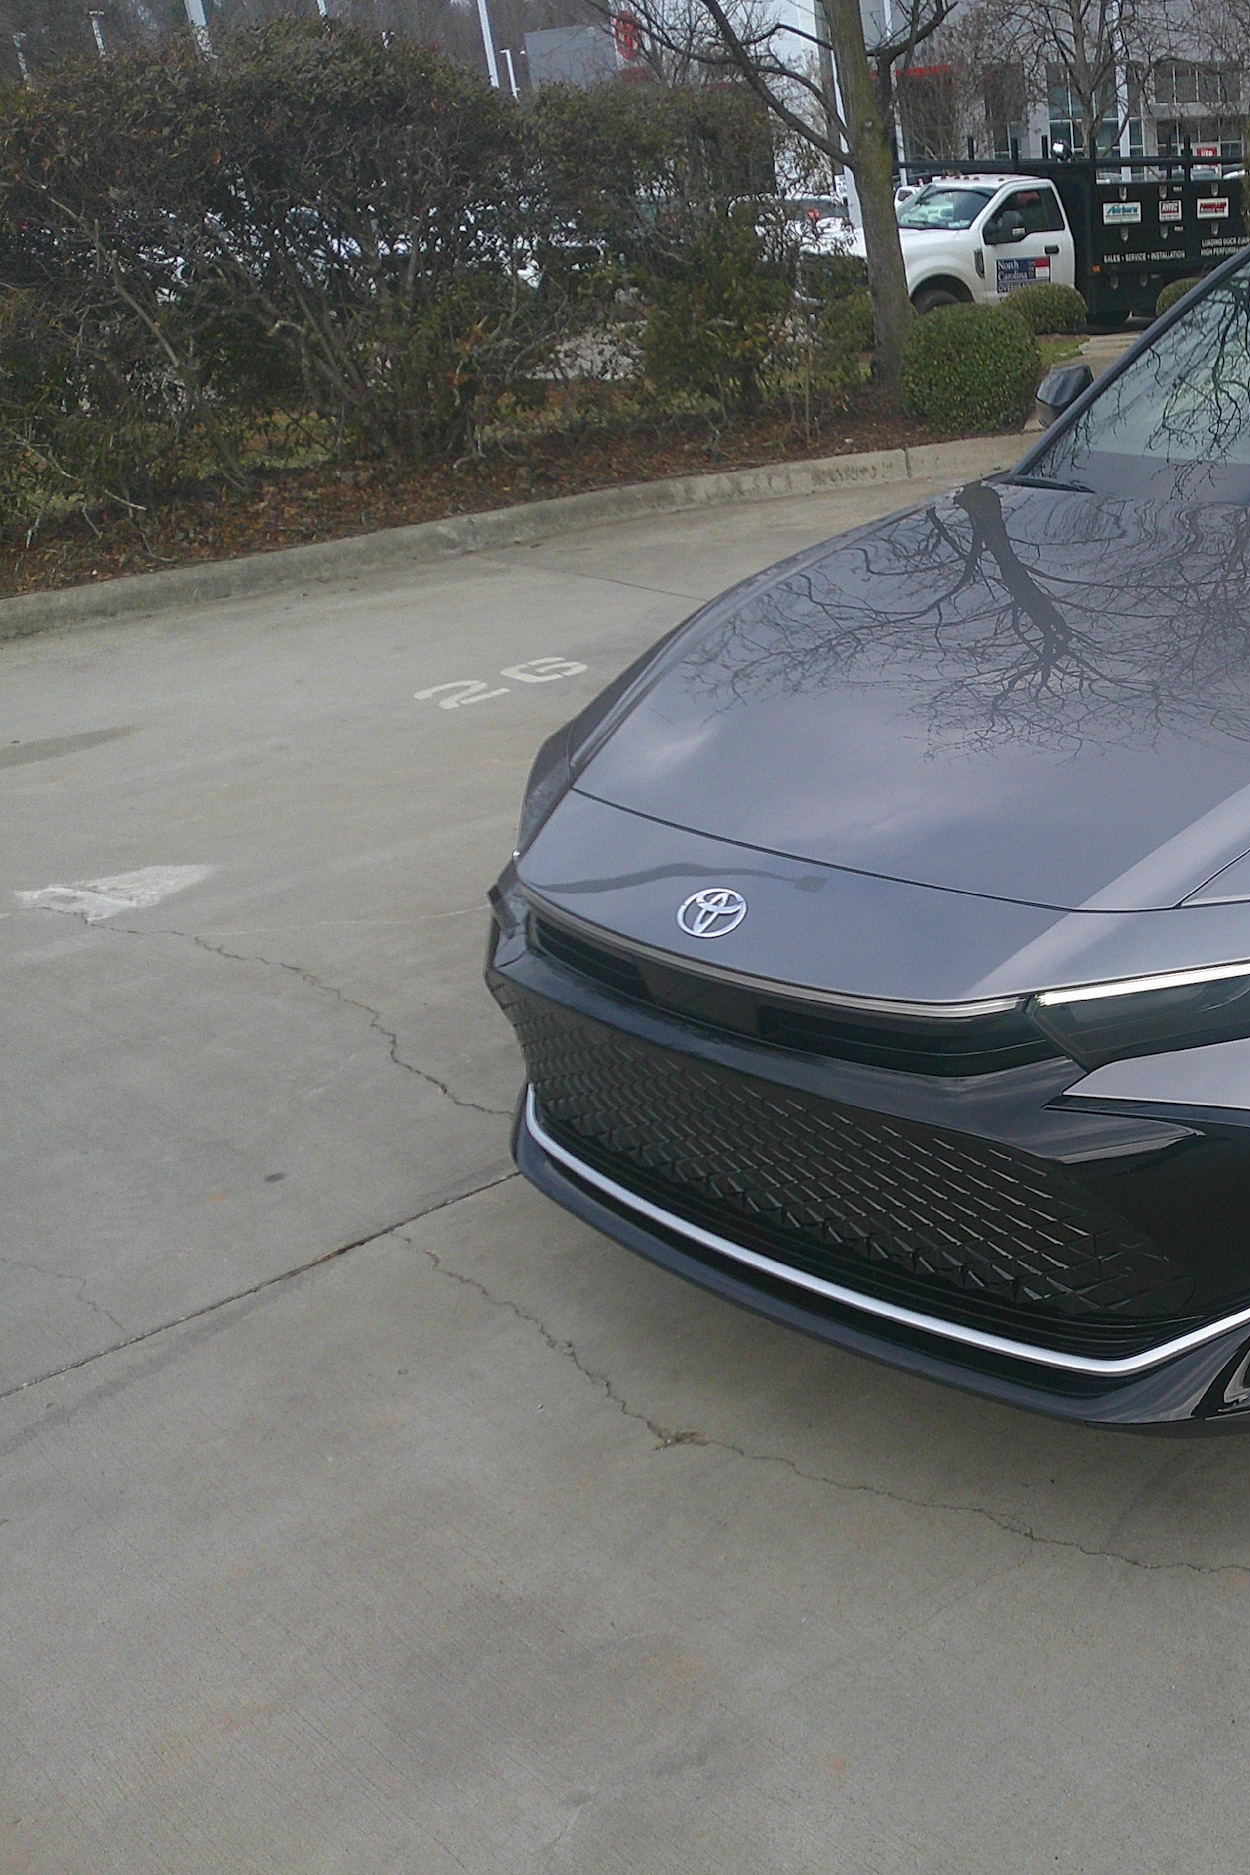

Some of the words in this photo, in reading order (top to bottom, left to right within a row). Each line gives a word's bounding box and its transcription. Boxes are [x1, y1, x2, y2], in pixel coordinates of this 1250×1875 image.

[1201, 238, 1223, 248] LOADING
[1223, 237, 1237, 246] DOCK
[1103, 253, 1121, 264] SALES
[1125, 252, 1147, 263] SERVICE
[1150, 250, 1186, 262] INSTALLATION
[1201, 248, 1213, 257] HIGH
[998, 259, 1019, 271] North
[998, 270, 1028, 281] Carolina
[412, 656, 589, 710] 26
